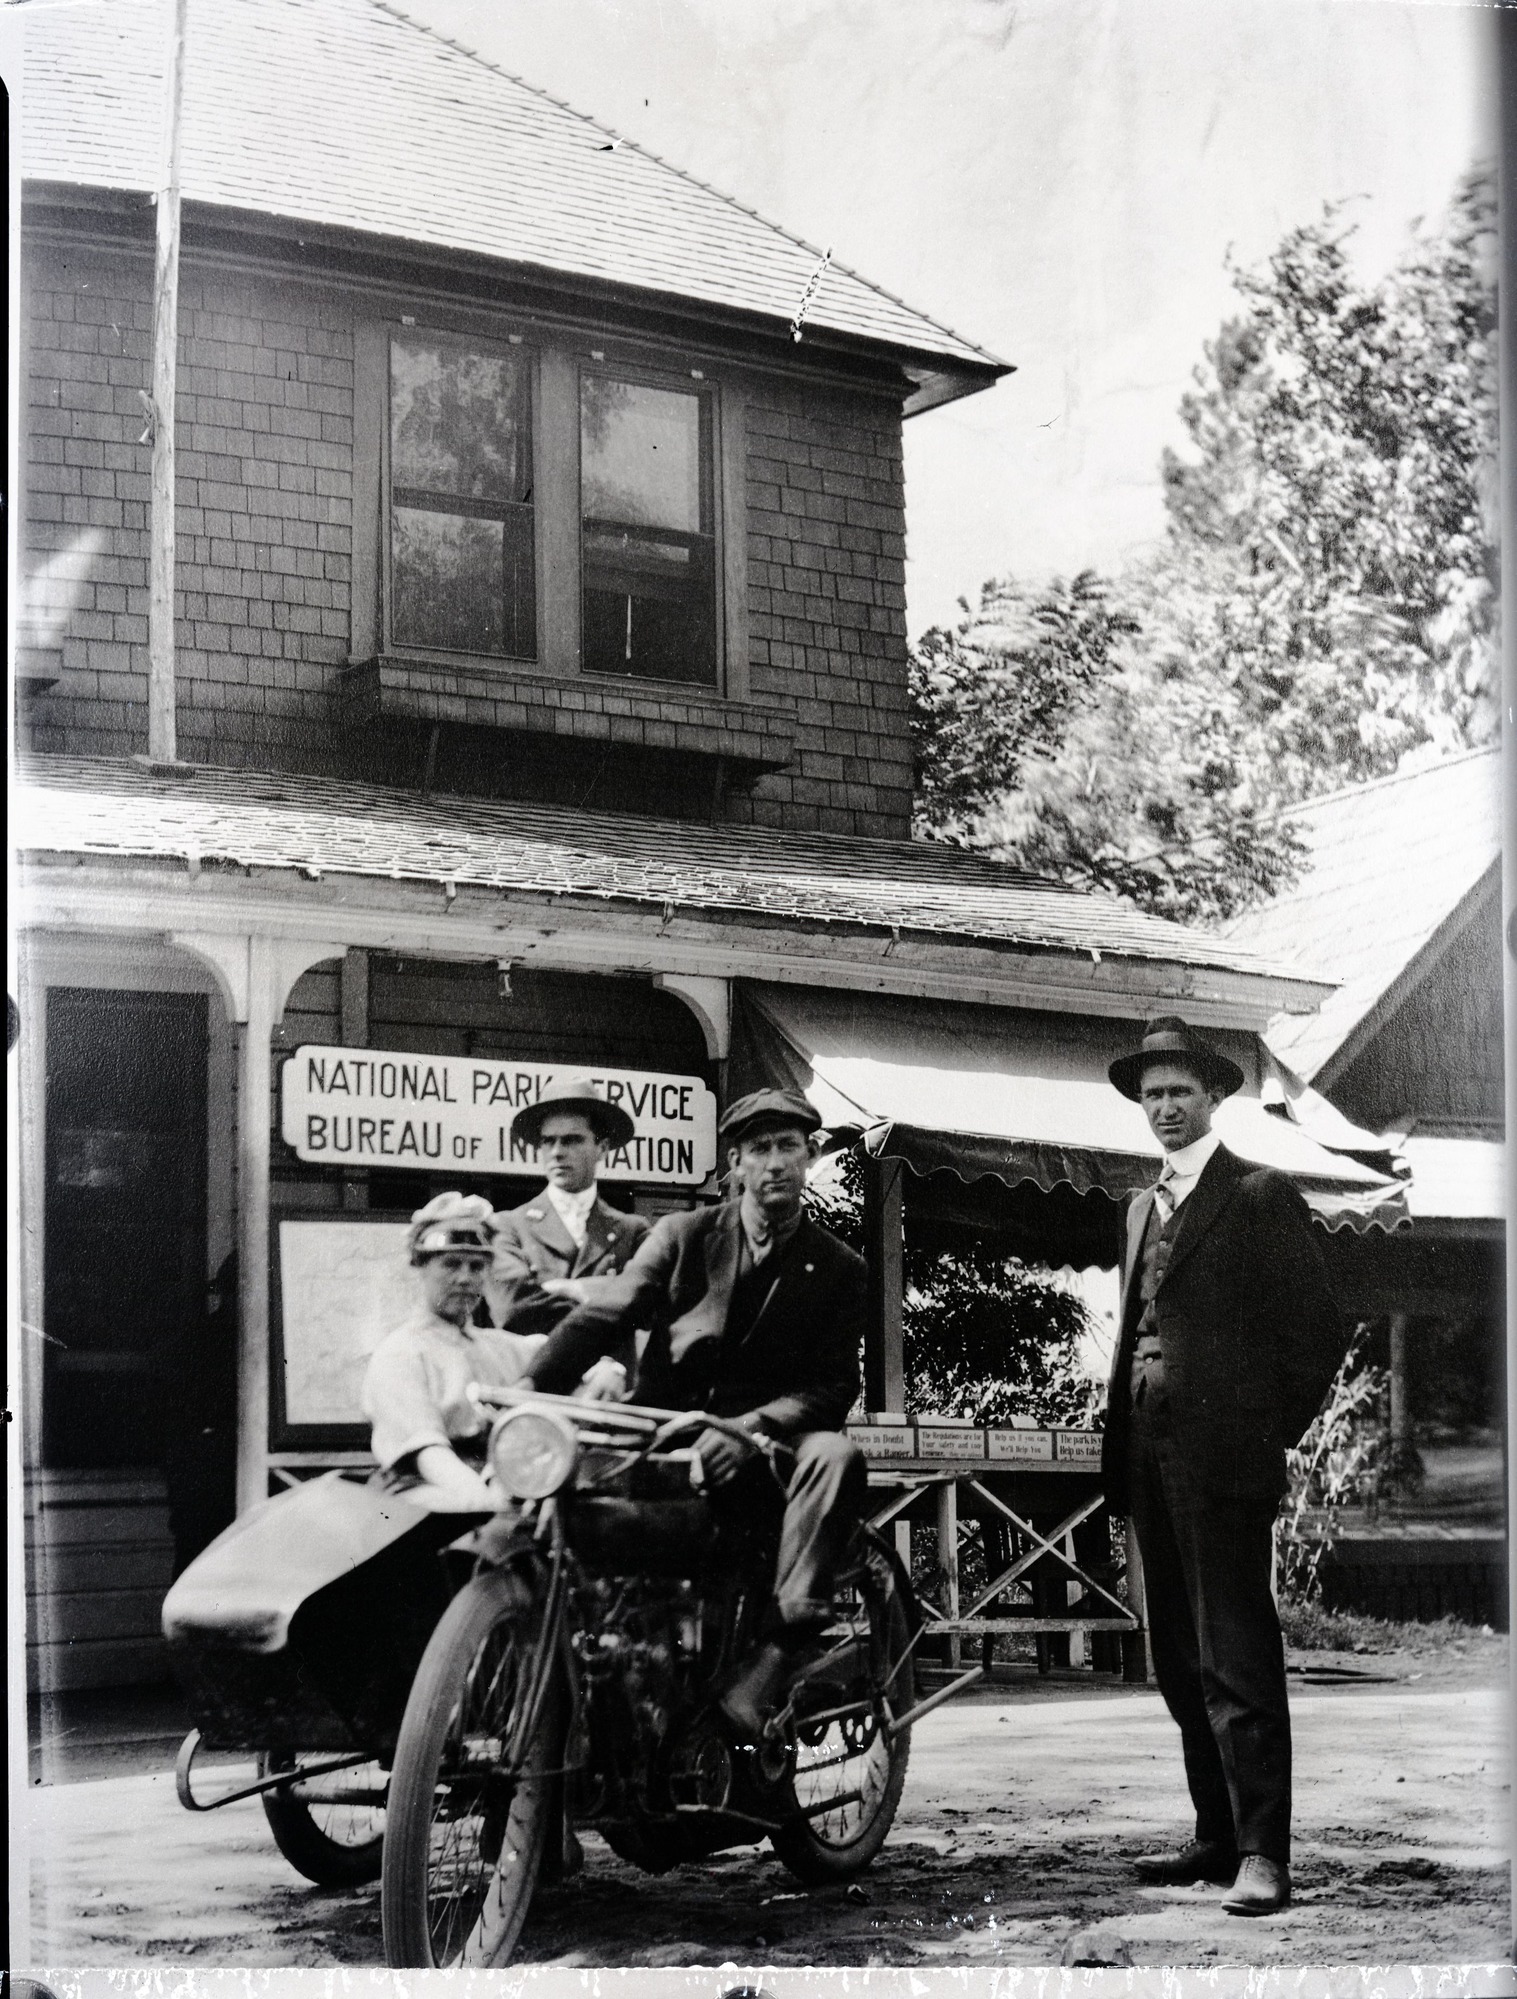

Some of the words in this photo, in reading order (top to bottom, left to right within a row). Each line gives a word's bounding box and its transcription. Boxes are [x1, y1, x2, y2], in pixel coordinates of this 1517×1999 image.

[308, 1057, 457, 1103] NATIONAL
[473, 1069, 553, 1107] PARK
[591, 1078, 694, 1121] RVICE
[308, 1115, 442, 1159] BUREAU
[453, 1135, 482, 1159] OF
[499, 1126, 694, 1174] INATION
[851, 1433, 871, 1443] When
[873, 1433, 880, 1443] in
[883, 1433, 904, 1444] Doubt
[974, 1433, 982, 1441] for
[995, 1433, 1006, 1442] Help
[1061, 1434, 1072, 1444] The
[1073, 1435, 1089, 1445] park
[1091, 1435, 1097, 1444] is
[958, 1441, 968, 1449] and
[1016, 1445, 1028, 1454] Help
[1060, 1445, 1074, 1457] Help
